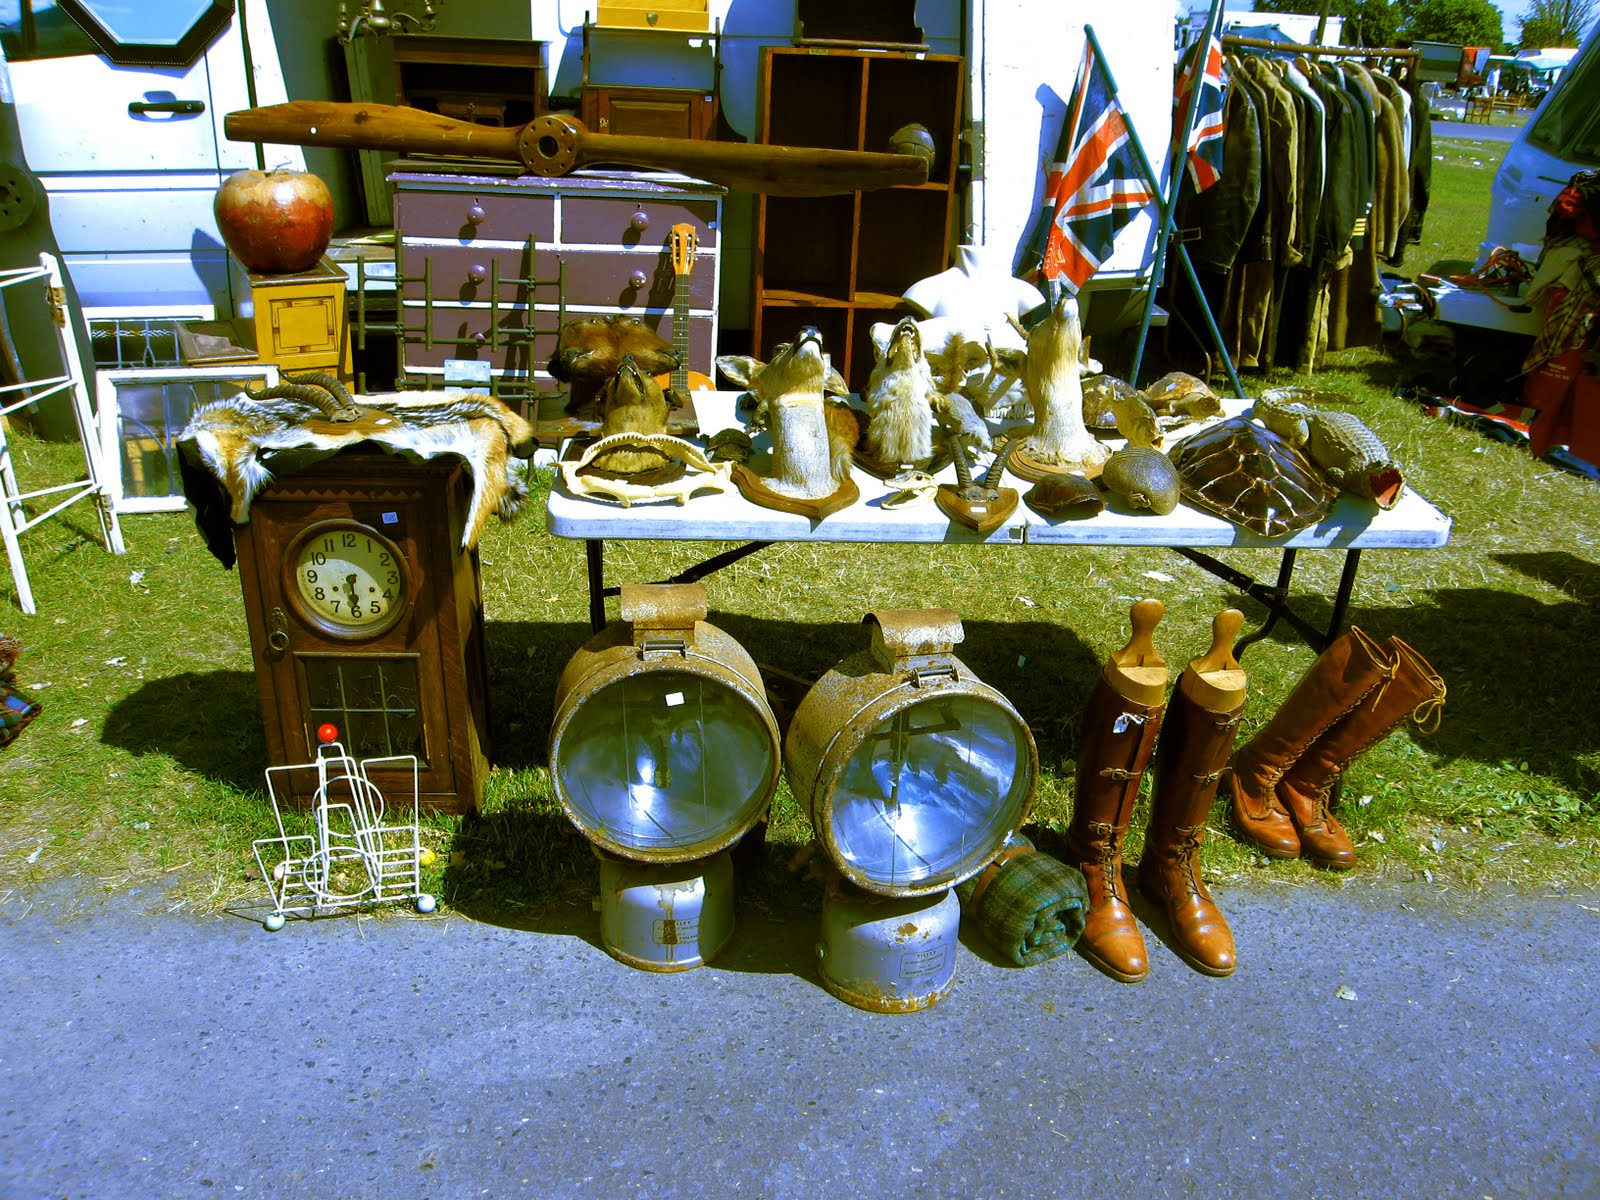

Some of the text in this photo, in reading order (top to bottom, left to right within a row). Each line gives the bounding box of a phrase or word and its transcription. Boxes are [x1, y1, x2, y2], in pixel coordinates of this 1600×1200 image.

[324, 538, 335, 552] 11
[342, 533, 357, 548] 12
[366, 539, 372, 553] 1
[311, 552, 326, 566] 10
[379, 552, 390, 567] 2
[306, 570, 318, 584] 9
[387, 571, 399, 585] 3
[314, 587, 325, 601] 8
[382, 589, 394, 601] 4
[330, 600, 341, 613] 7
[351, 604, 362, 618] 6
[370, 600, 381, 614] 5
